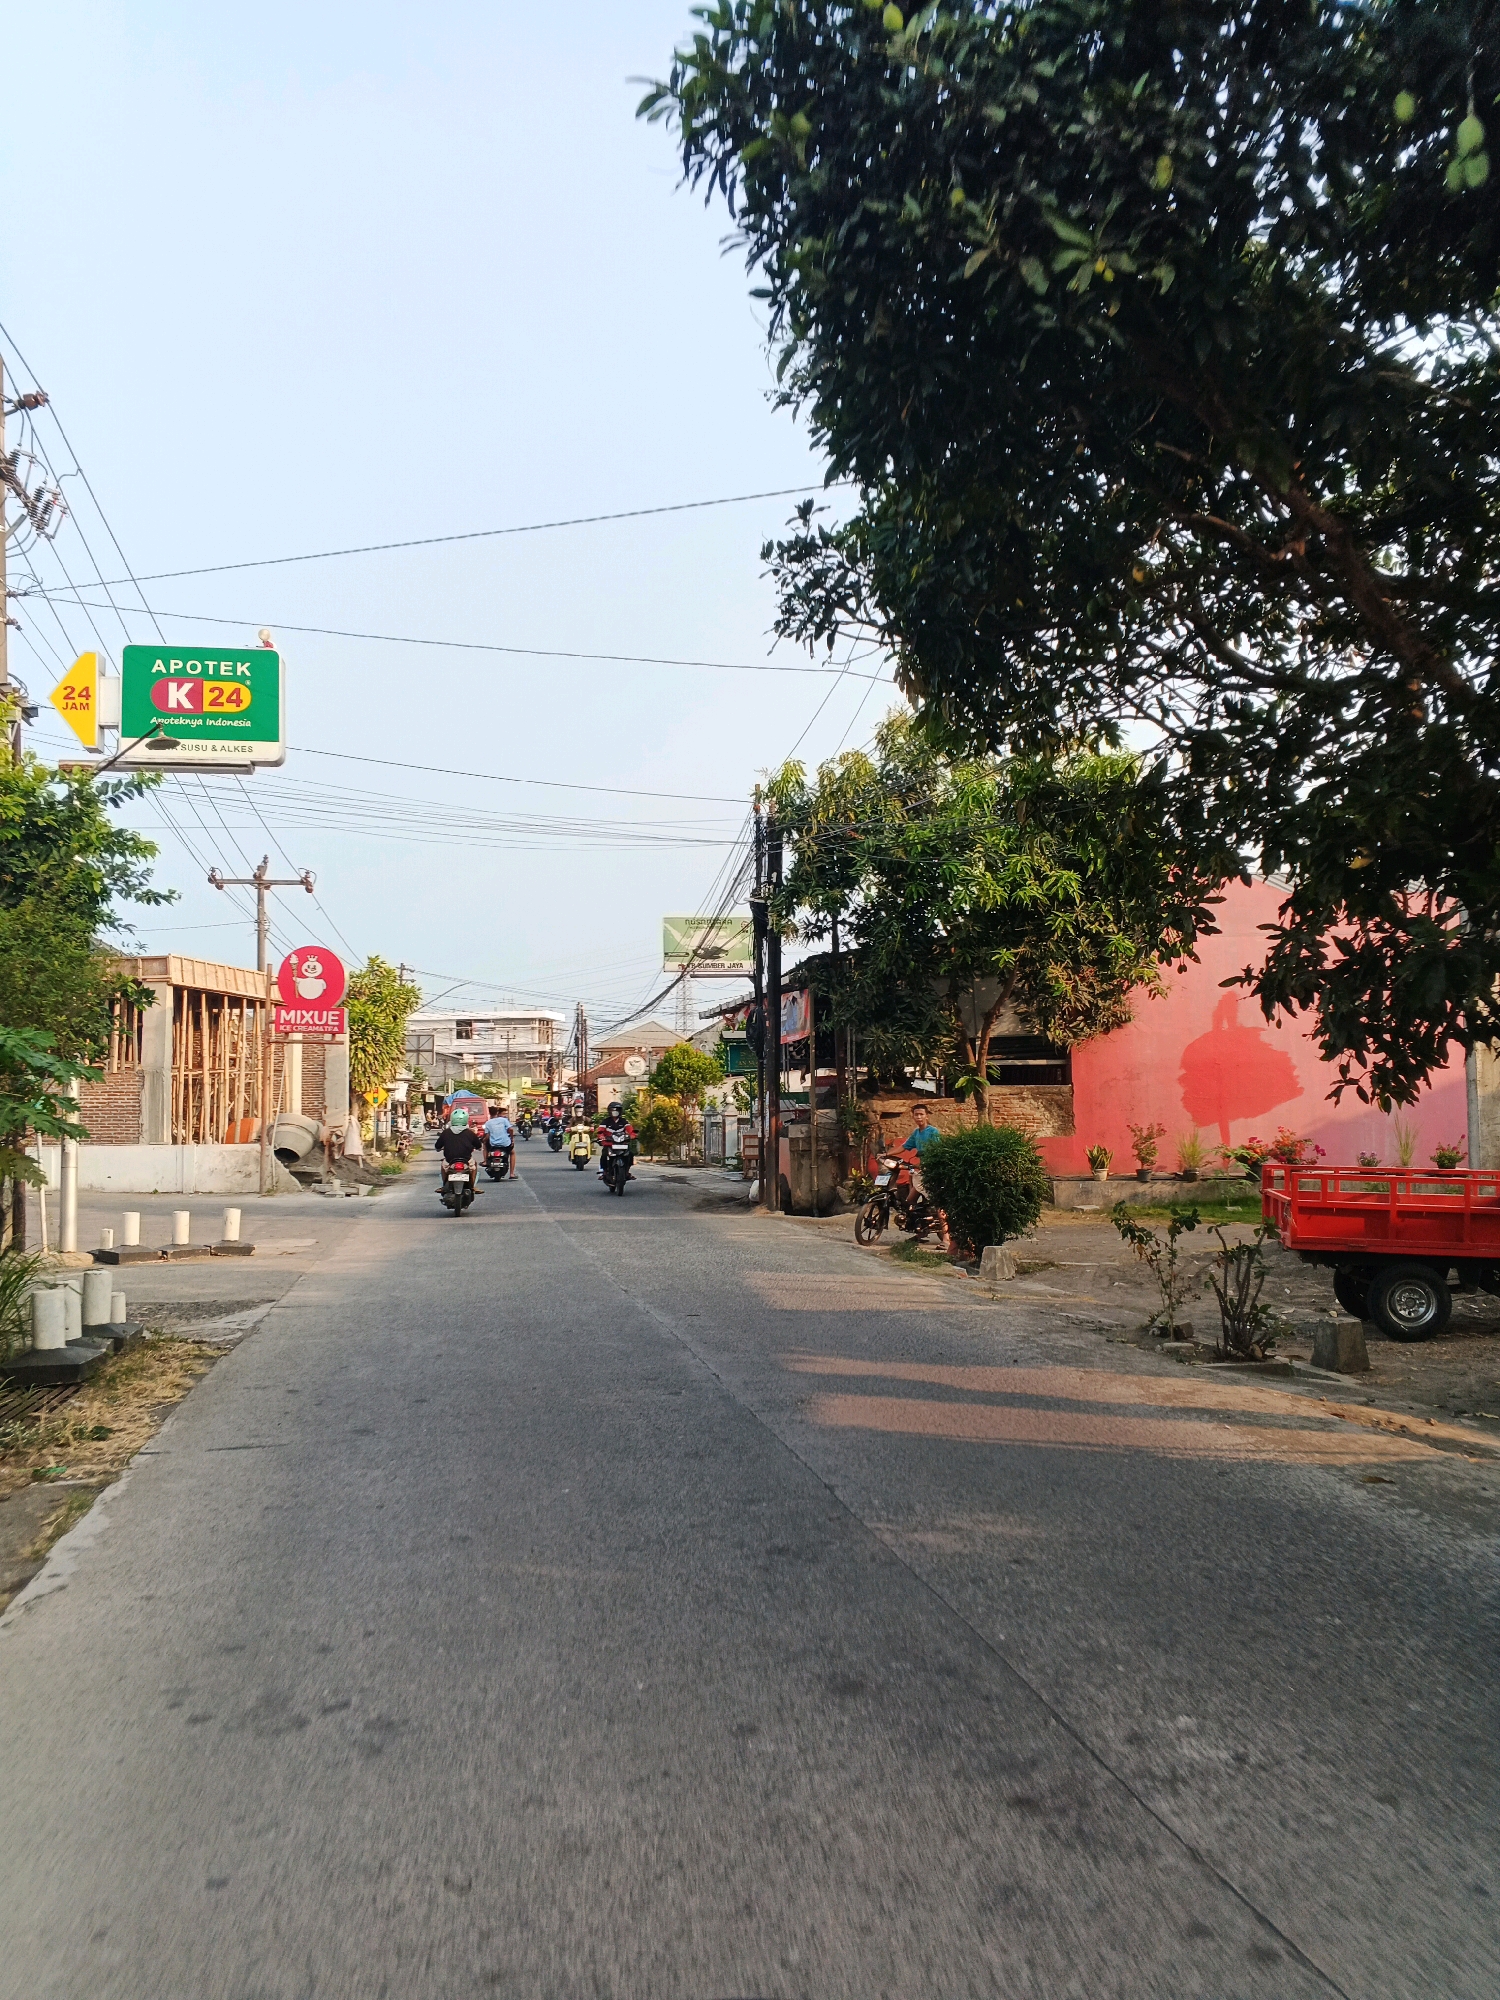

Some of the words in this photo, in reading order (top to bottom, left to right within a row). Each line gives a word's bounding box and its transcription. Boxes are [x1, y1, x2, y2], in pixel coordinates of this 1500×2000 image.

[151, 659, 252, 677] APOTEK
[62, 685, 91, 701] 24
[167, 682, 194, 710] K
[208, 687, 243, 708] 24
[62, 701, 90, 711] JAM
[150, 716, 203, 728] Apoteknya
[206, 717, 252, 727] Indonesia
[180, 743, 208, 752] SUSU
[211, 744, 218, 752] &
[220, 745, 254, 753] ALKES
[280, 1009, 341, 1026] MIXUE
